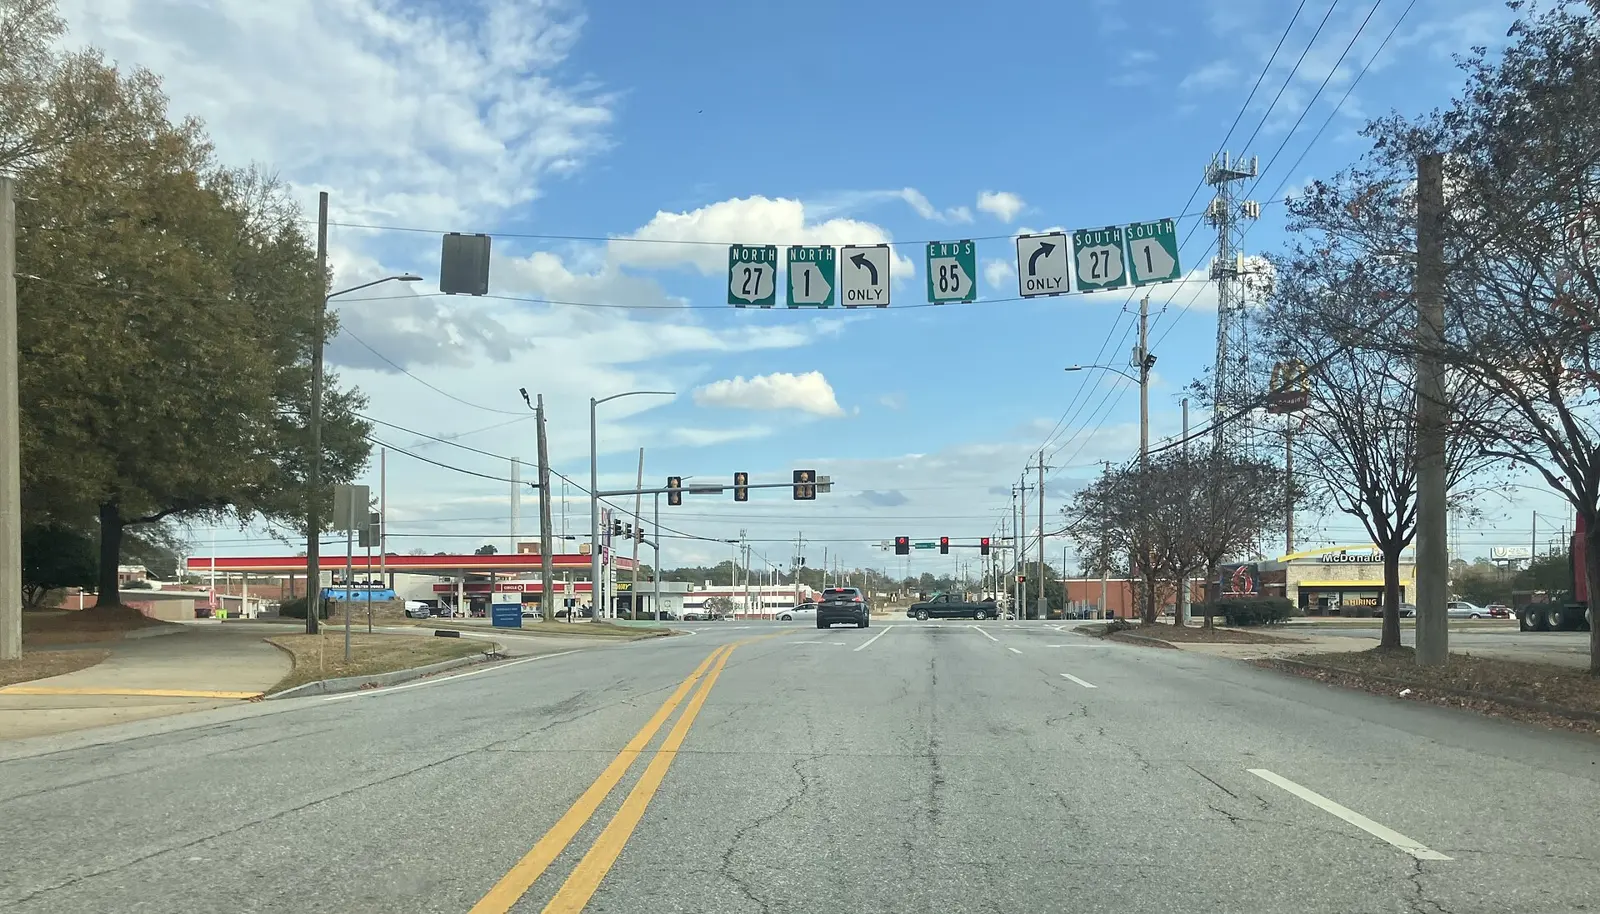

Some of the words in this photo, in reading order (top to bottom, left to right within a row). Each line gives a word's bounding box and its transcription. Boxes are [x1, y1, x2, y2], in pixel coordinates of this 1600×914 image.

[1075, 228, 1121, 246] SOUTH
[1127, 223, 1173, 239] SOUTH
[732, 249, 775, 261] NORTH
[790, 249, 833, 261] NORTH
[930, 244, 971, 256] ENDS
[1089, 250, 1110, 279] 27
[1143, 245, 1153, 273] 1
[741, 267, 763, 295] 27
[803, 269, 810, 297] 1
[939, 264, 960, 293] 85
[1026, 276, 1062, 291] ONLY
[847, 289, 883, 301] ONLY
[1322, 553, 1384, 563] McDonald
[1231, 565, 1253, 594] 6
[1349, 598, 1377, 606] HIRING
